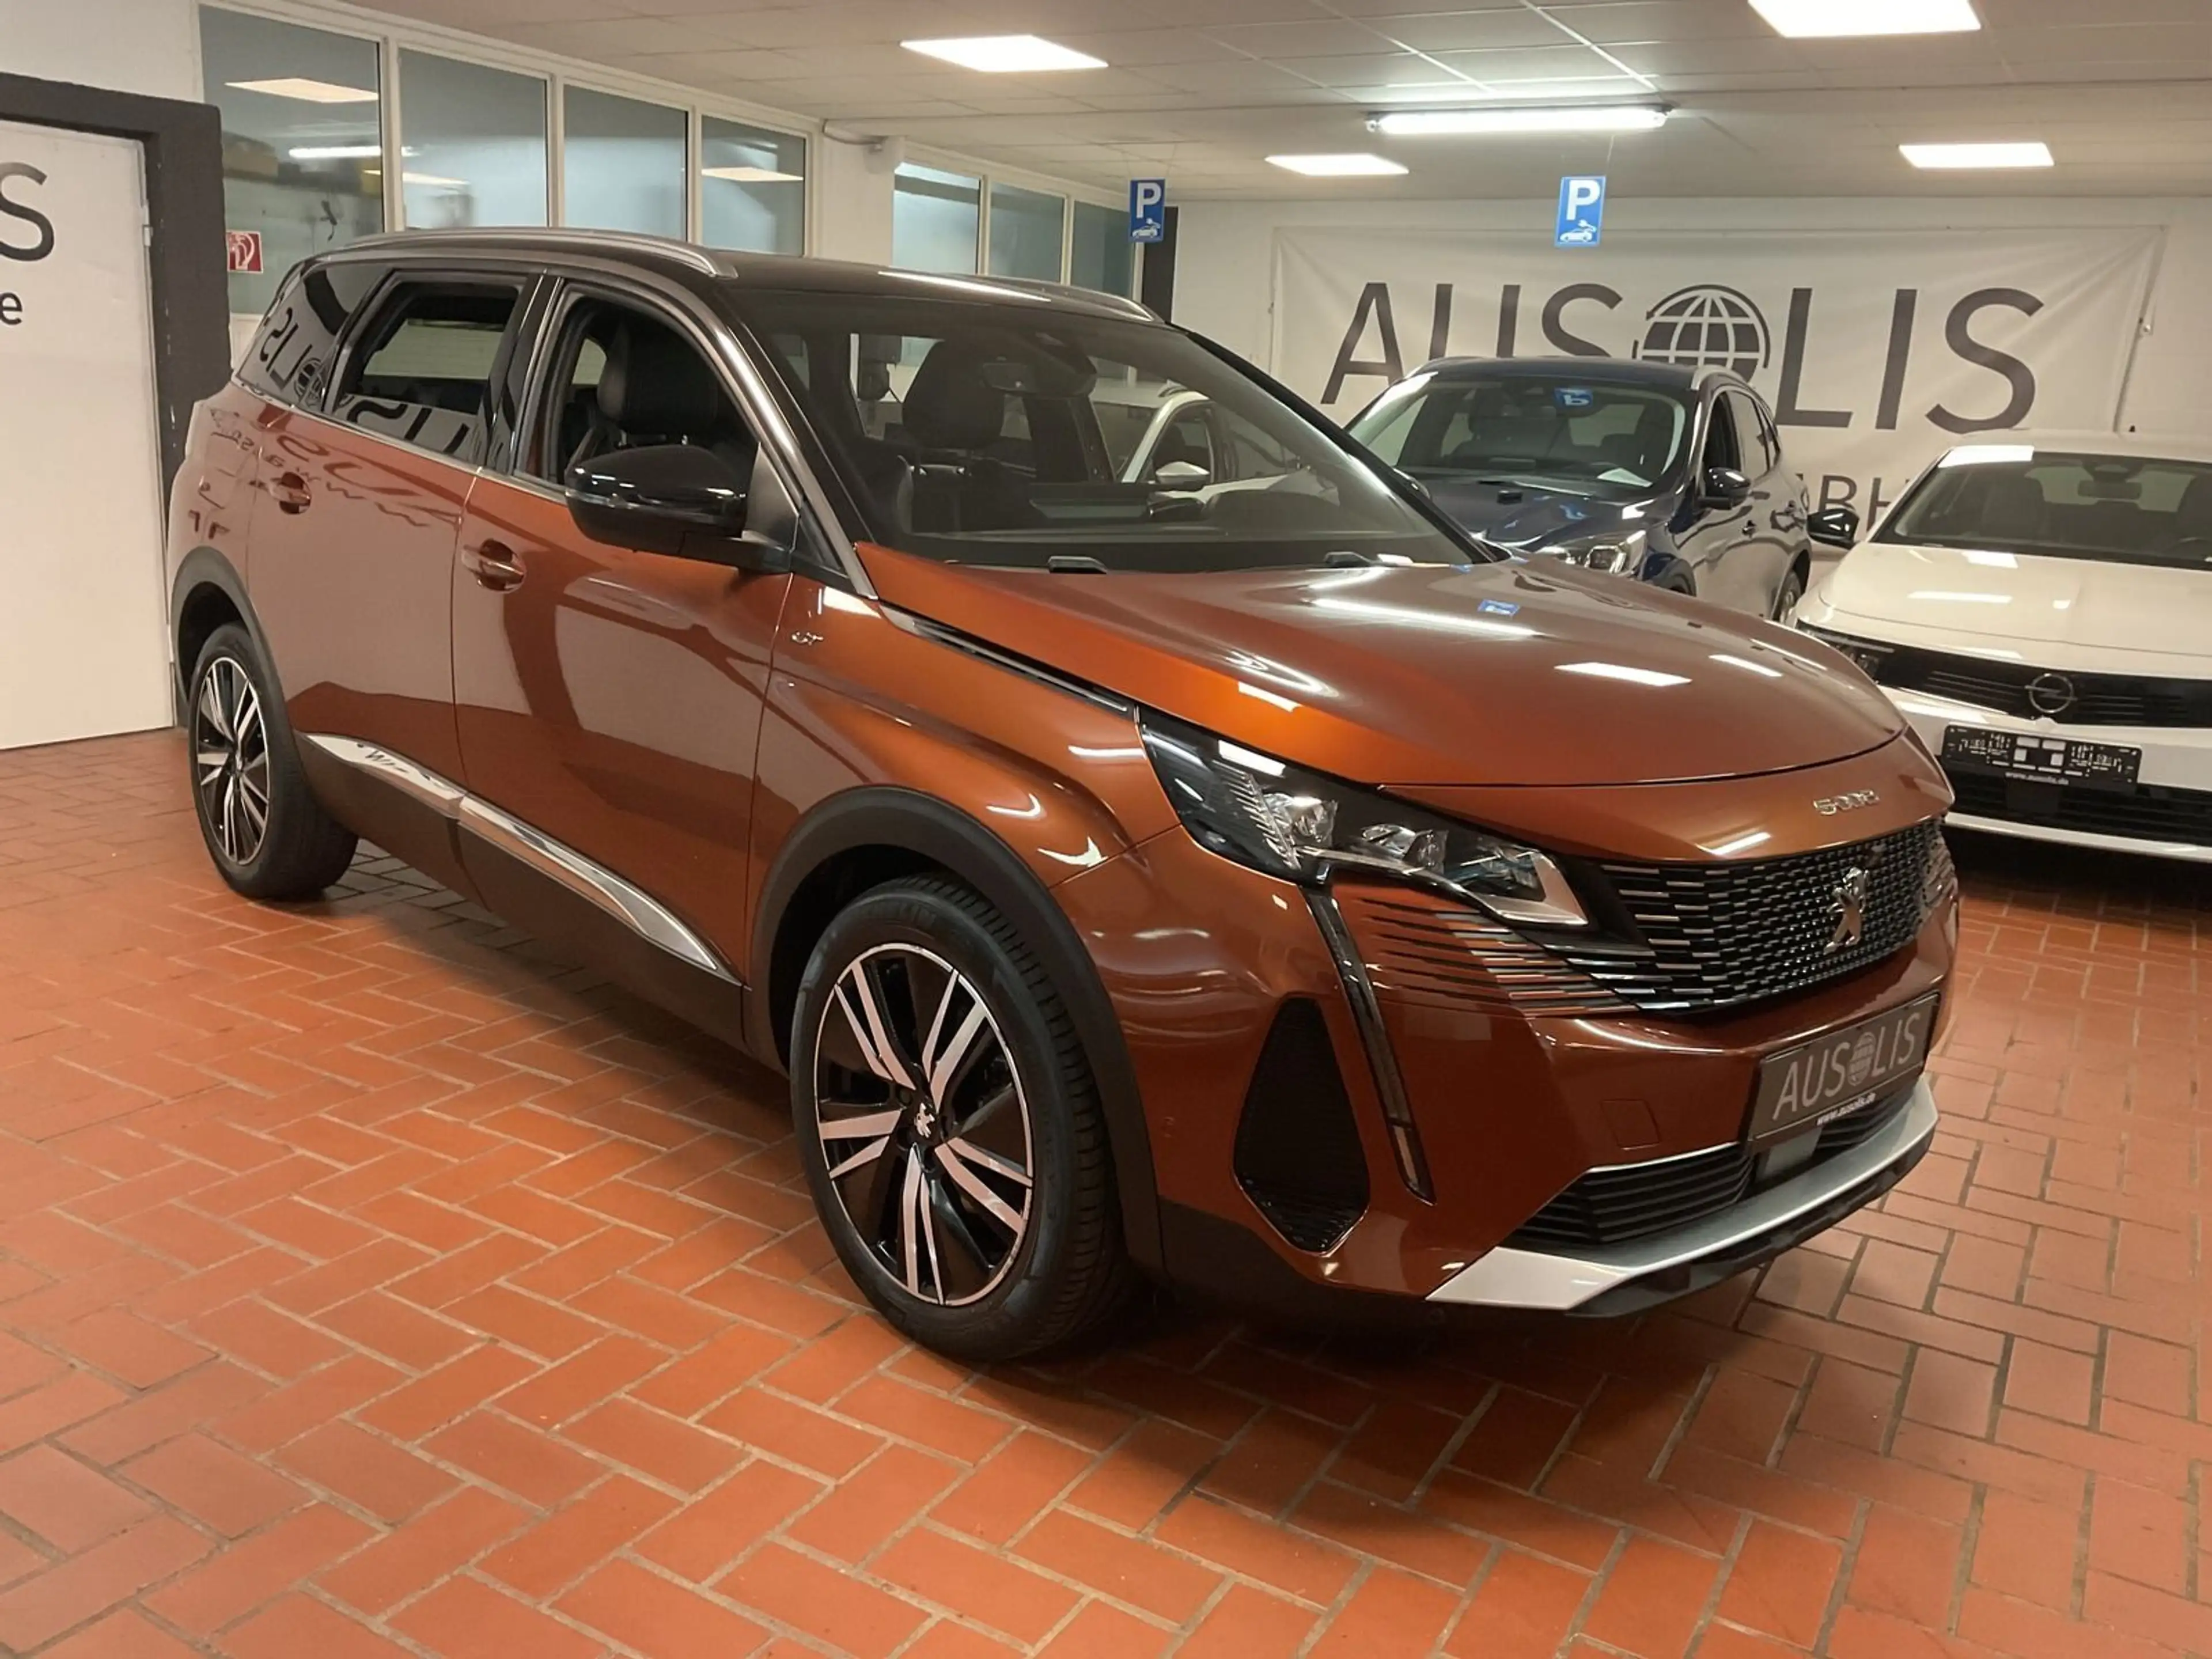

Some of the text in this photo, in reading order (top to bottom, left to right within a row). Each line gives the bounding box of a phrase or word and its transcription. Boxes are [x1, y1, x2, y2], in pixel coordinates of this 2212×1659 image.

[1137, 182, 1162, 218] P
[1566, 180, 1600, 220] P
[1772, 1013, 1921, 1121] AUSOLIS
